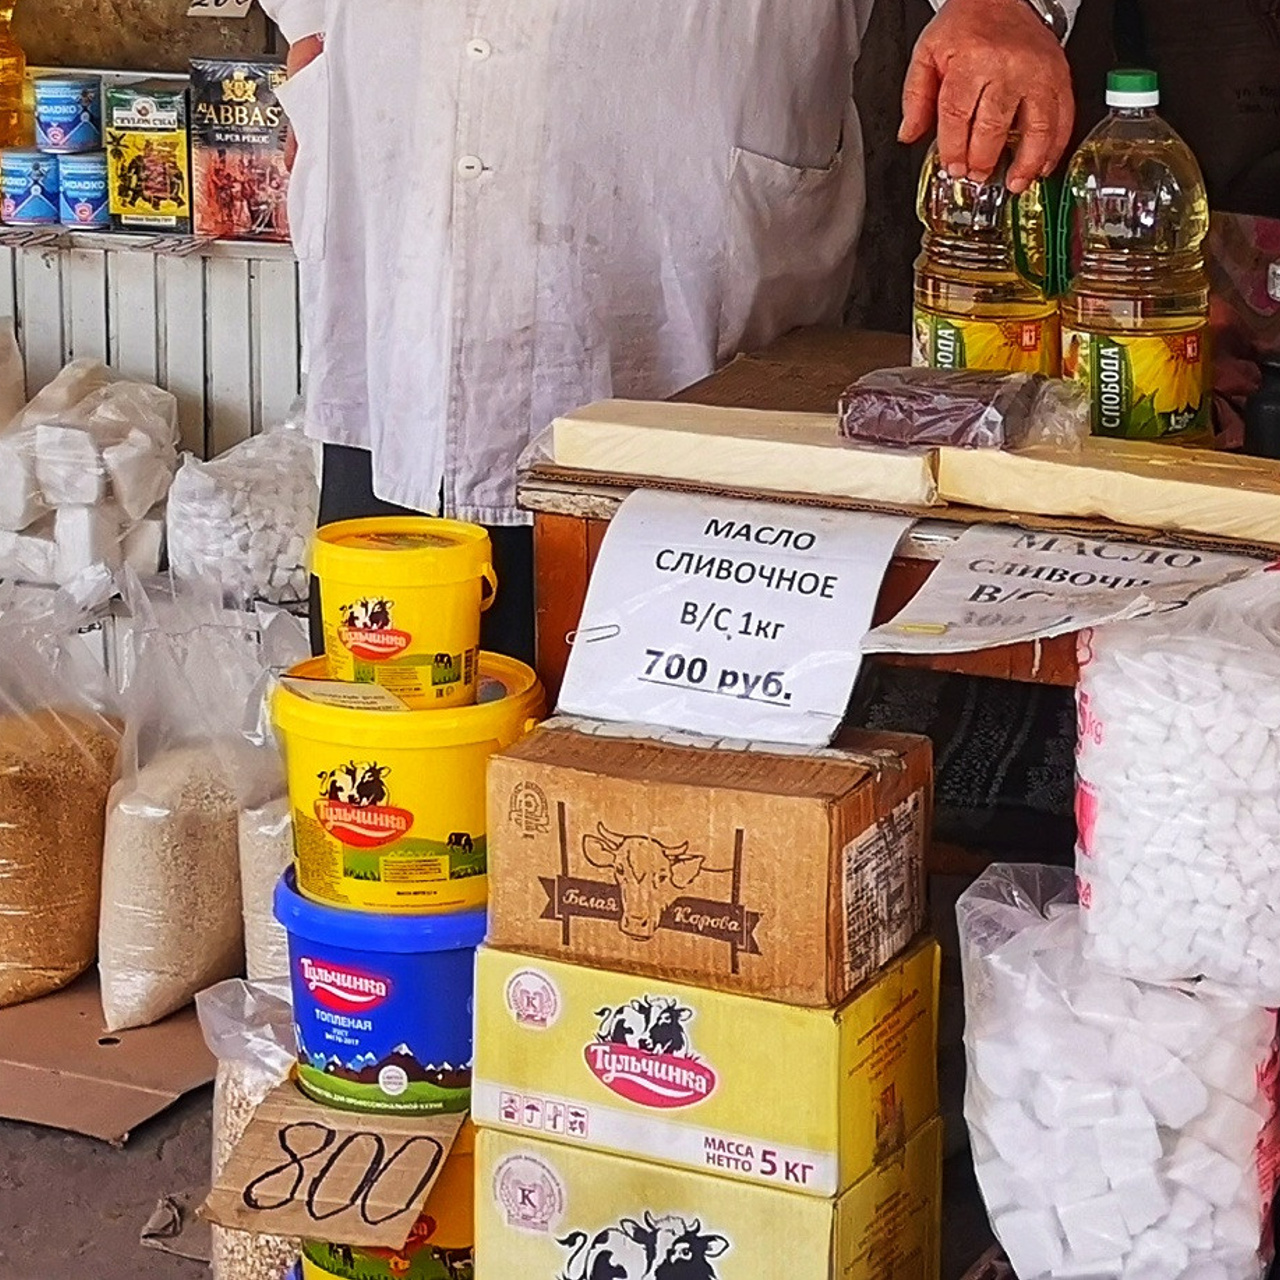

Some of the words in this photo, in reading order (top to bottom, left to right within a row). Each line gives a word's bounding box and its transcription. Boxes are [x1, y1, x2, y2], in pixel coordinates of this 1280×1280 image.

[204, 104, 281, 128] ABBAS
[1101, 346, 1119, 429] СЛОБОДА
[703, 518, 816, 551] МАСЛО
[1011, 533, 1203, 569] МАСЛО
[655, 549, 838, 599] СЛИВОЧНОЕ
[341, 627, 407, 649] Тульчинка
[738, 611, 785, 640] 1кг
[644, 649, 708, 684] 700
[718, 666, 793, 700] руб.
[316, 800, 407, 831] Тульчинка
[562, 888, 619, 911] Белая
[673, 906, 741, 931] Корова
[300, 957, 387, 997] Тульчинка
[314, 1008, 372, 1031] ТОПЛЕНАЯ
[590, 1045, 708, 1094] Тульчинка
[704, 1136, 754, 1158] МАССА
[706, 1152, 753, 1172] НЕТТО
[242, 1121, 444, 1225] 800
[760, 1149, 778, 1176] 5
[785, 1160, 814, 1184] КГ
